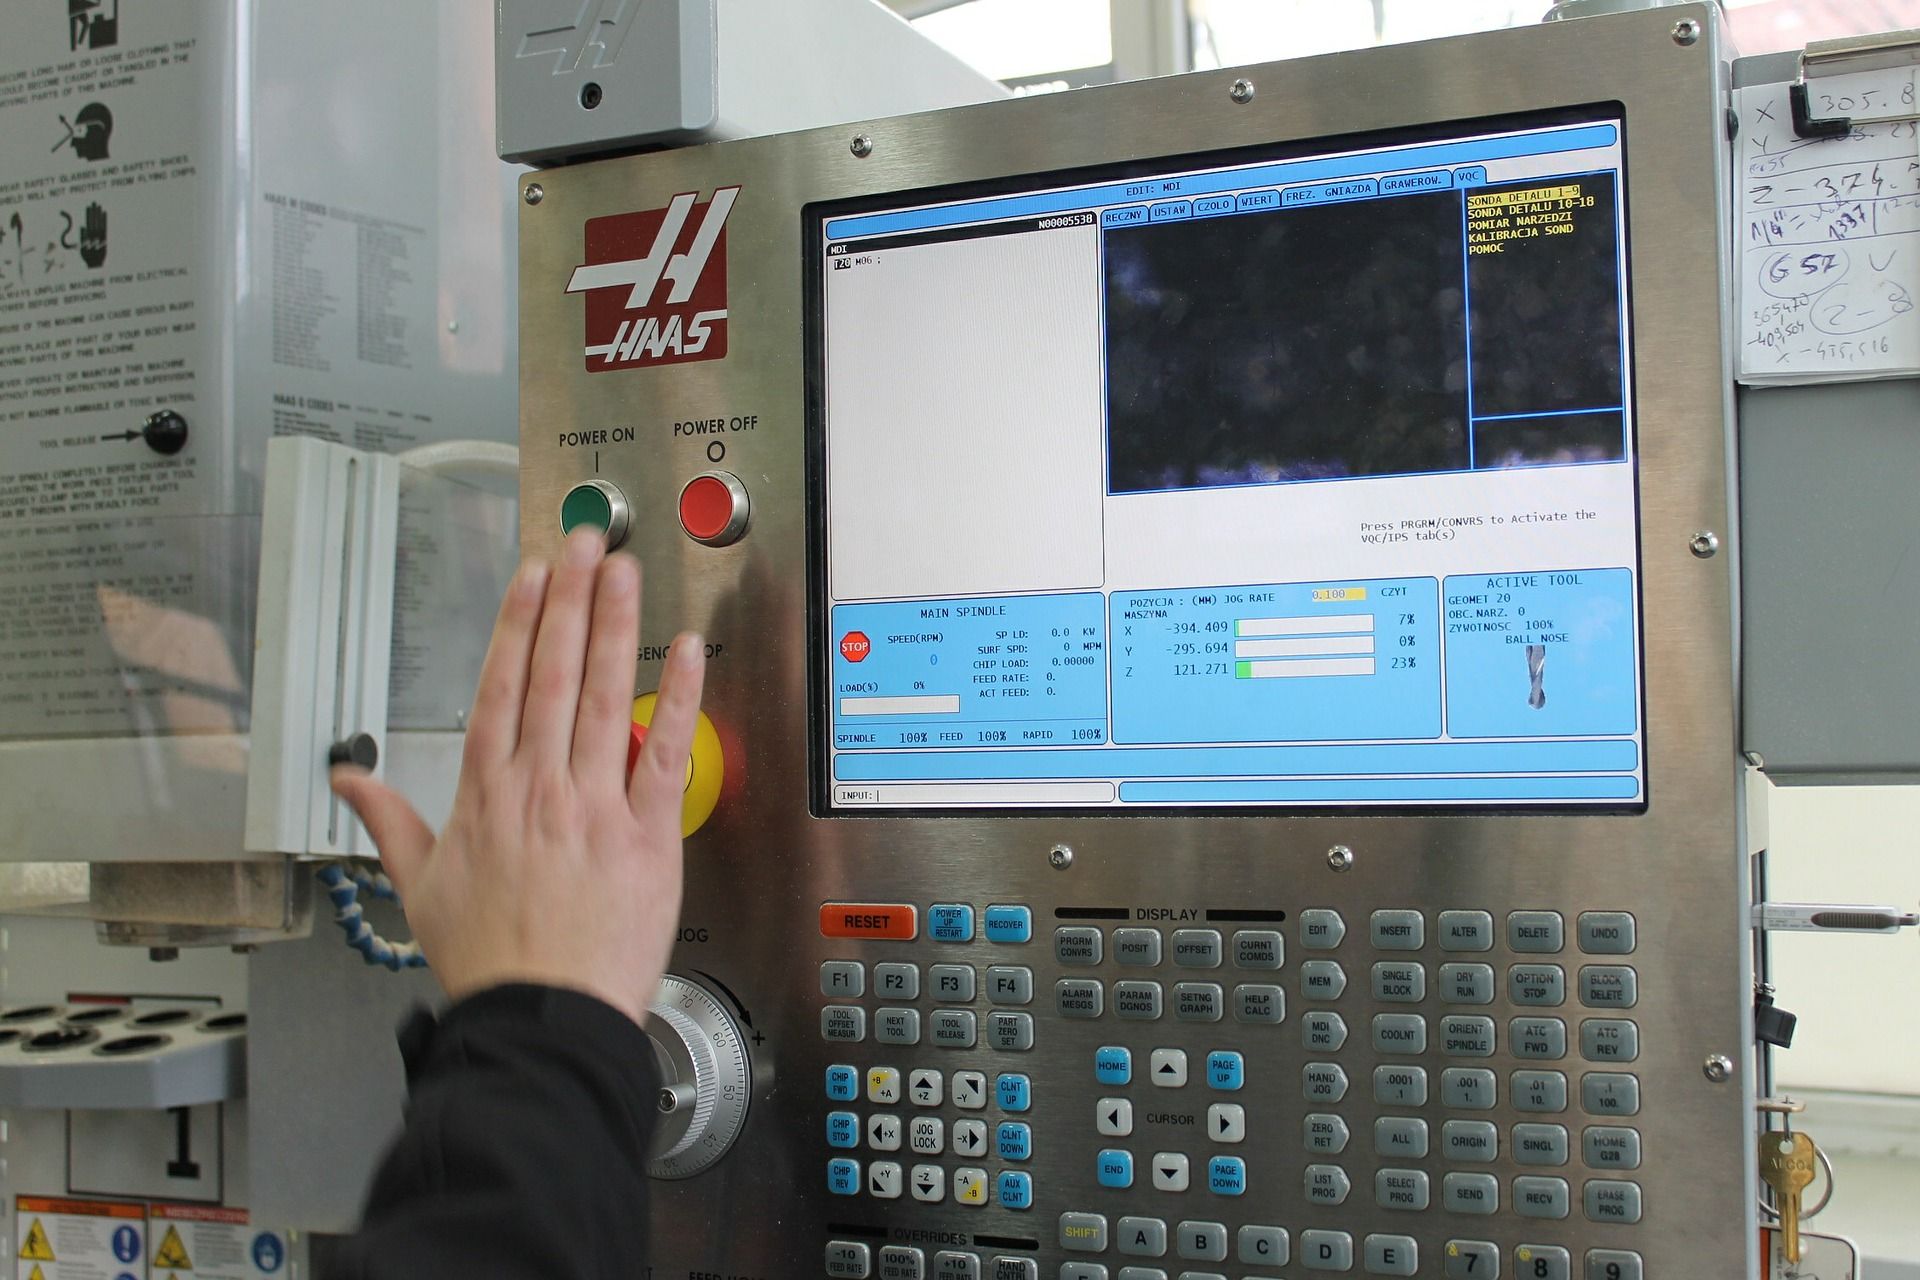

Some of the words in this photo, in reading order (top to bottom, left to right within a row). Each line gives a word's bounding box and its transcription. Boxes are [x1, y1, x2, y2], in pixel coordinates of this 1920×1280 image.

[1458, 172, 1479, 182] VQC
[1126, 185, 1154, 196] EDIT:
[1163, 182, 1180, 192] MDI
[1384, 178, 1442, 190] GRAWEROW.
[1286, 190, 1316, 202] FREZ.
[1325, 184, 1371, 197] GNIAZDA
[1468, 196, 1502, 207] SONDA
[1509, 190, 1552, 202] DETALU
[1558, 186, 1580, 198] 1-9
[1198, 200, 1230, 212] CZOLO
[1242, 195, 1272, 206] WIERT
[1154, 206, 1185, 217] USTAW
[1468, 208, 1502, 220] SONDA
[1510, 202, 1552, 215] DETALU
[1558, 196, 1594, 210] 10-18
[1039, 214, 1092, 229] N00005538
[1106, 210, 1142, 222] RECZNY
[1468, 219, 1510, 231] POMIAR
[1516, 212, 1572, 226] NARZEDZI
[1468, 228, 1538, 242] KALIBRACJA
[1545, 224, 1574, 235] SOND
[831, 244, 848, 254] MDI
[1469, 243, 1504, 255] POMOC
[834, 258, 851, 270] T20
[856, 256, 872, 266] M06
[585, 308, 728, 363] HAAS
[674, 419, 725, 436] POWER
[730, 416, 758, 431] OFF
[560, 430, 607, 447] POWER
[612, 428, 634, 442] ON
[1361, 520, 1393, 532] Press
[1400, 516, 1483, 530] PRGRM/CONVRS
[1491, 514, 1504, 524] to
[1512, 510, 1568, 524] Activate
[1576, 509, 1596, 520] the
[1362, 532, 1408, 544] VQC/IPS
[1416, 528, 1456, 542] tab(s)
[1487, 576, 1538, 588] ACTIVE
[1549, 574, 1582, 586] TOOL
[1130, 598, 1174, 608] POZYCJA
[1224, 594, 1243, 604] JOG
[1249, 592, 1274, 602] RATE
[1312, 589, 1345, 600] 0.100
[1381, 587, 1408, 597] CZYT
[1448, 594, 1488, 605] GEOMET
[1496, 592, 1510, 603] 20
[920, 608, 949, 619] MAIN
[956, 605, 1006, 618] SPINDLE
[1124, 609, 1168, 620] MASZYNA
[1518, 606, 1525, 616] 0
[1124, 626, 1132, 636] X
[1165, 622, 1228, 634] -394.409
[1400, 614, 1415, 625] 7%
[1450, 622, 1512, 632] ZYWOTNOSC
[1526, 620, 1554, 630] 100%
[888, 632, 944, 644] SPEED(RPM)
[996, 630, 1008, 640] SP
[1012, 630, 1028, 639] LD:
[1052, 628, 1070, 638] 0.0
[1082, 627, 1095, 636] KW
[1506, 634, 1533, 644] BALL
[1541, 632, 1568, 643] NOSE
[842, 642, 868, 652] STOP
[1124, 646, 1132, 656] Y
[1166, 642, 1228, 655] -295.694
[1400, 635, 1416, 647] 0%
[1126, 666, 1132, 678] Z
[1174, 664, 1228, 676] 121.271
[1392, 656, 1416, 669] 23%
[840, 682, 878, 692] LOAD(%)
[914, 680, 924, 690] 0%
[842, 791, 872, 800] INPUT:
[1136, 908, 1198, 920] DISPLAY
[844, 916, 890, 928] RESET
[988, 920, 1022, 928] RECOVER
[676, 928, 708, 942] JOG
[1308, 926, 1328, 935] EDIT
[1380, 926, 1411, 936] INSERT
[1451, 927, 1476, 936] ALTER
[1518, 928, 1549, 938] DELETE
[1592, 928, 1618, 938] UNDO
[1060, 936, 1092, 946] PRGRM
[1060, 948, 1092, 957] CONVRS
[1122, 944, 1148, 953] POSIT
[1177, 946, 1212, 955] OFFSET
[832, 973, 848, 986] F1
[886, 975, 903, 988] F2
[1309, 976, 1330, 986] MEM
[1382, 971, 1412, 980] SINGLE
[940, 977, 958, 990] F3
[998, 979, 1016, 992] F4
[1062, 990, 1093, 998] ALARM
[1383, 986, 1411, 995] BLOCK
[679, 994, 694, 1009] 70
[1062, 1000, 1094, 1010] MESGS
[886, 1017, 904, 1025] NEXT
[886, 1028, 904, 1036] TOOL
[712, 1032, 726, 1048] 60
[1098, 1062, 1126, 1071] HOME
[1212, 1060, 1234, 1070] PAGE
[1218, 1074, 1230, 1082] UP
[724, 1085, 735, 1100] 50
[1146, 1113, 1194, 1125] CURSOR
[916, 1124, 934, 1134] JOG
[704, 1132, 716, 1148] 40
[914, 1138, 936, 1148] LOCK
[1104, 1166, 1124, 1174] END
[894, 1230, 967, 1246] OVERRIDES
[1065, 1226, 1100, 1238] SHIFT
[1134, 1230, 1147, 1245] A
[1464, 1253, 1478, 1272] 7
